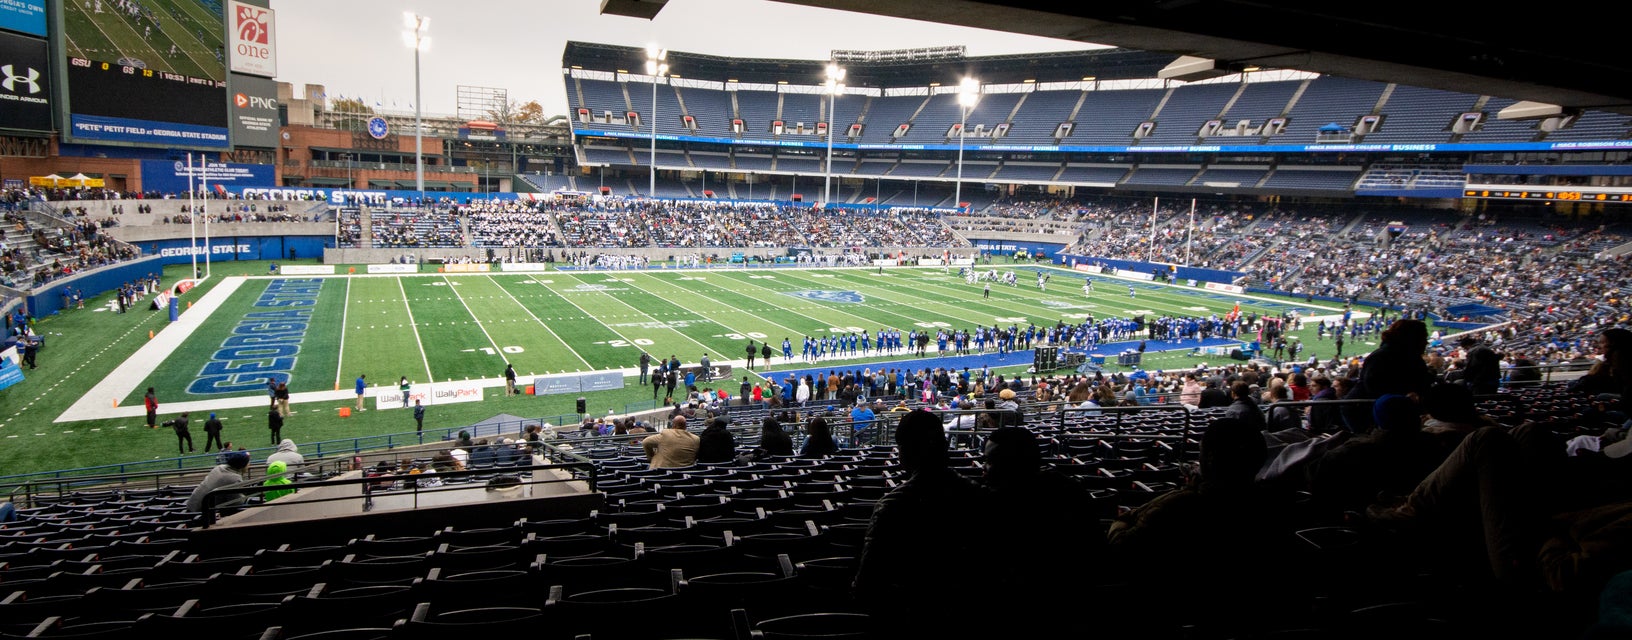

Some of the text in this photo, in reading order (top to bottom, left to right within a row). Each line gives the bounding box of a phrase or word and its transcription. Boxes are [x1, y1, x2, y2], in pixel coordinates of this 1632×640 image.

[28, 4, 44, 12] OWN
[238, 44, 269, 59] one
[72, 58, 109, 70] GSU 0
[123, 66, 153, 77] GS 13
[164, 73, 184, 82] 10:53
[250, 96, 276, 110] PNC
[153, 129, 181, 137] GEORGIA
[201, 132, 226, 140] STADIUM
[243, 188, 387, 204] GEORGIA STATE
[161, 244, 250, 257] GEORGIA STATE
[184, 308, 314, 395] GEORGIA
[252, 278, 326, 308] STATE
[724, 332, 768, 340] 30
[608, 338, 654, 348] 20
[478, 346, 524, 354] 10
[381, 392, 426, 402] Wallyark
[436, 388, 478, 398] WallyPark
